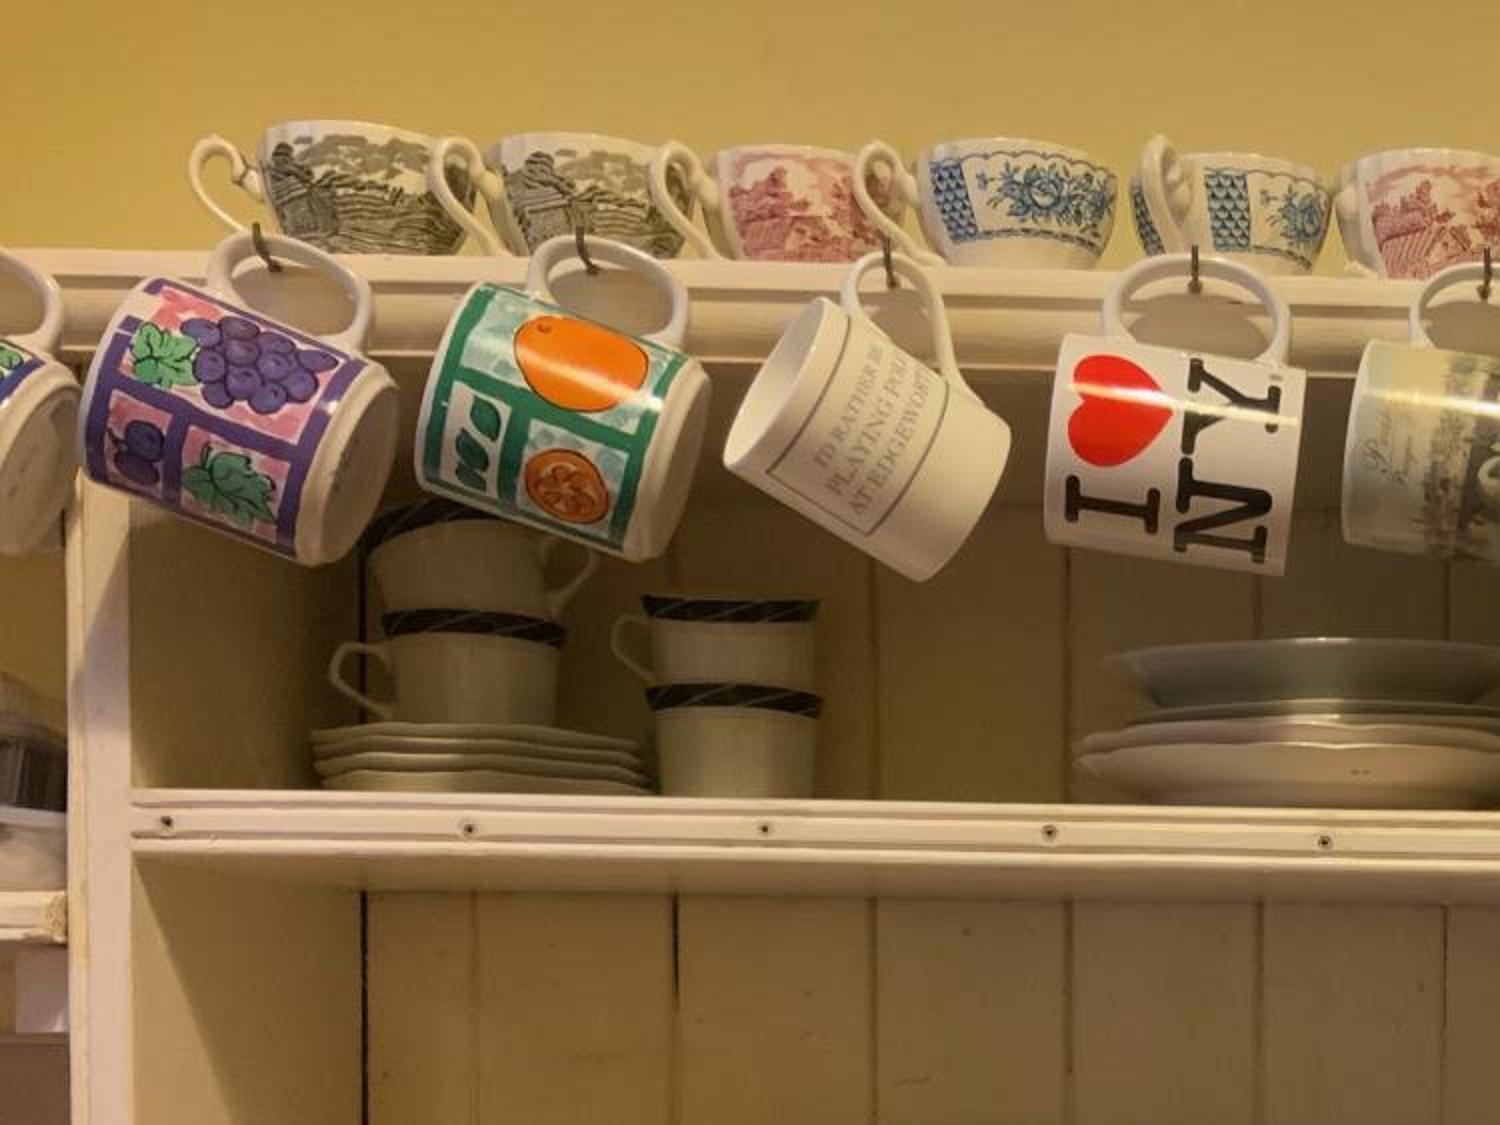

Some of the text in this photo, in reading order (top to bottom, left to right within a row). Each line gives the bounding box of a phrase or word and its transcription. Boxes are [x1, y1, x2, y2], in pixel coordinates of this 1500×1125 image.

[825, 397, 895, 496] PLAYING
[831, 364, 877, 442] RATHER
[1064, 474, 1162, 535] I
[1173, 357, 1285, 566] NY
